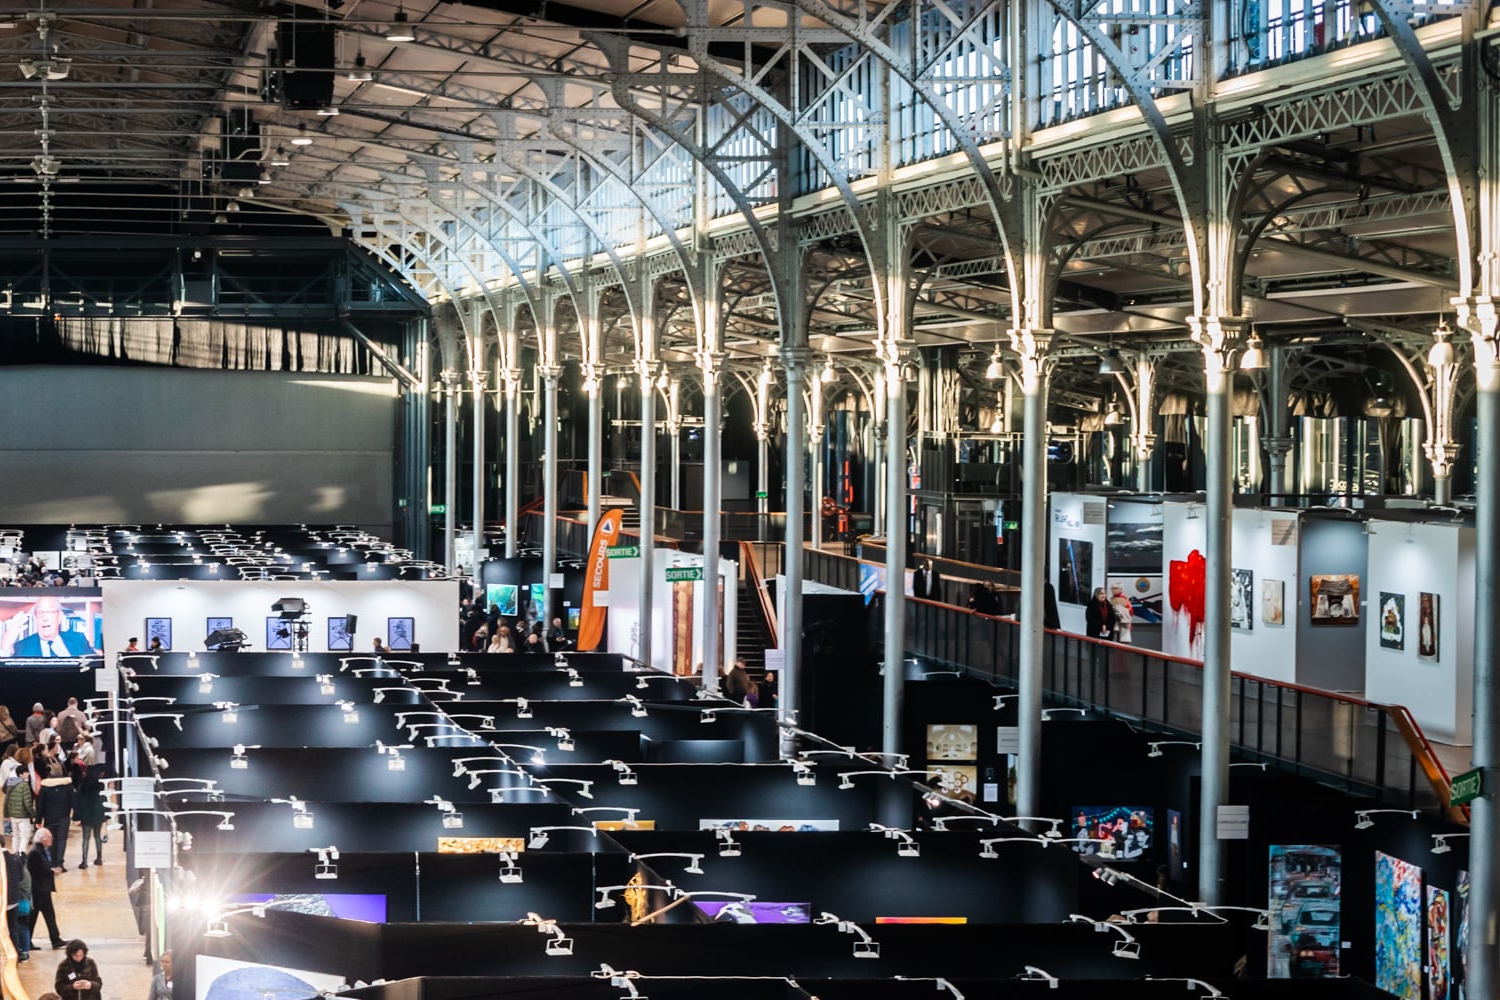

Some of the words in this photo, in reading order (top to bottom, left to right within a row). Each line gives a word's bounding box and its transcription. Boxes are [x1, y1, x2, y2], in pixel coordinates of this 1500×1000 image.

[606, 548, 633, 557] SORTIE
[593, 539, 608, 588] SECOURS
[665, 570, 695, 580] SORTIE
[1451, 776, 1476, 800] SORTIE
